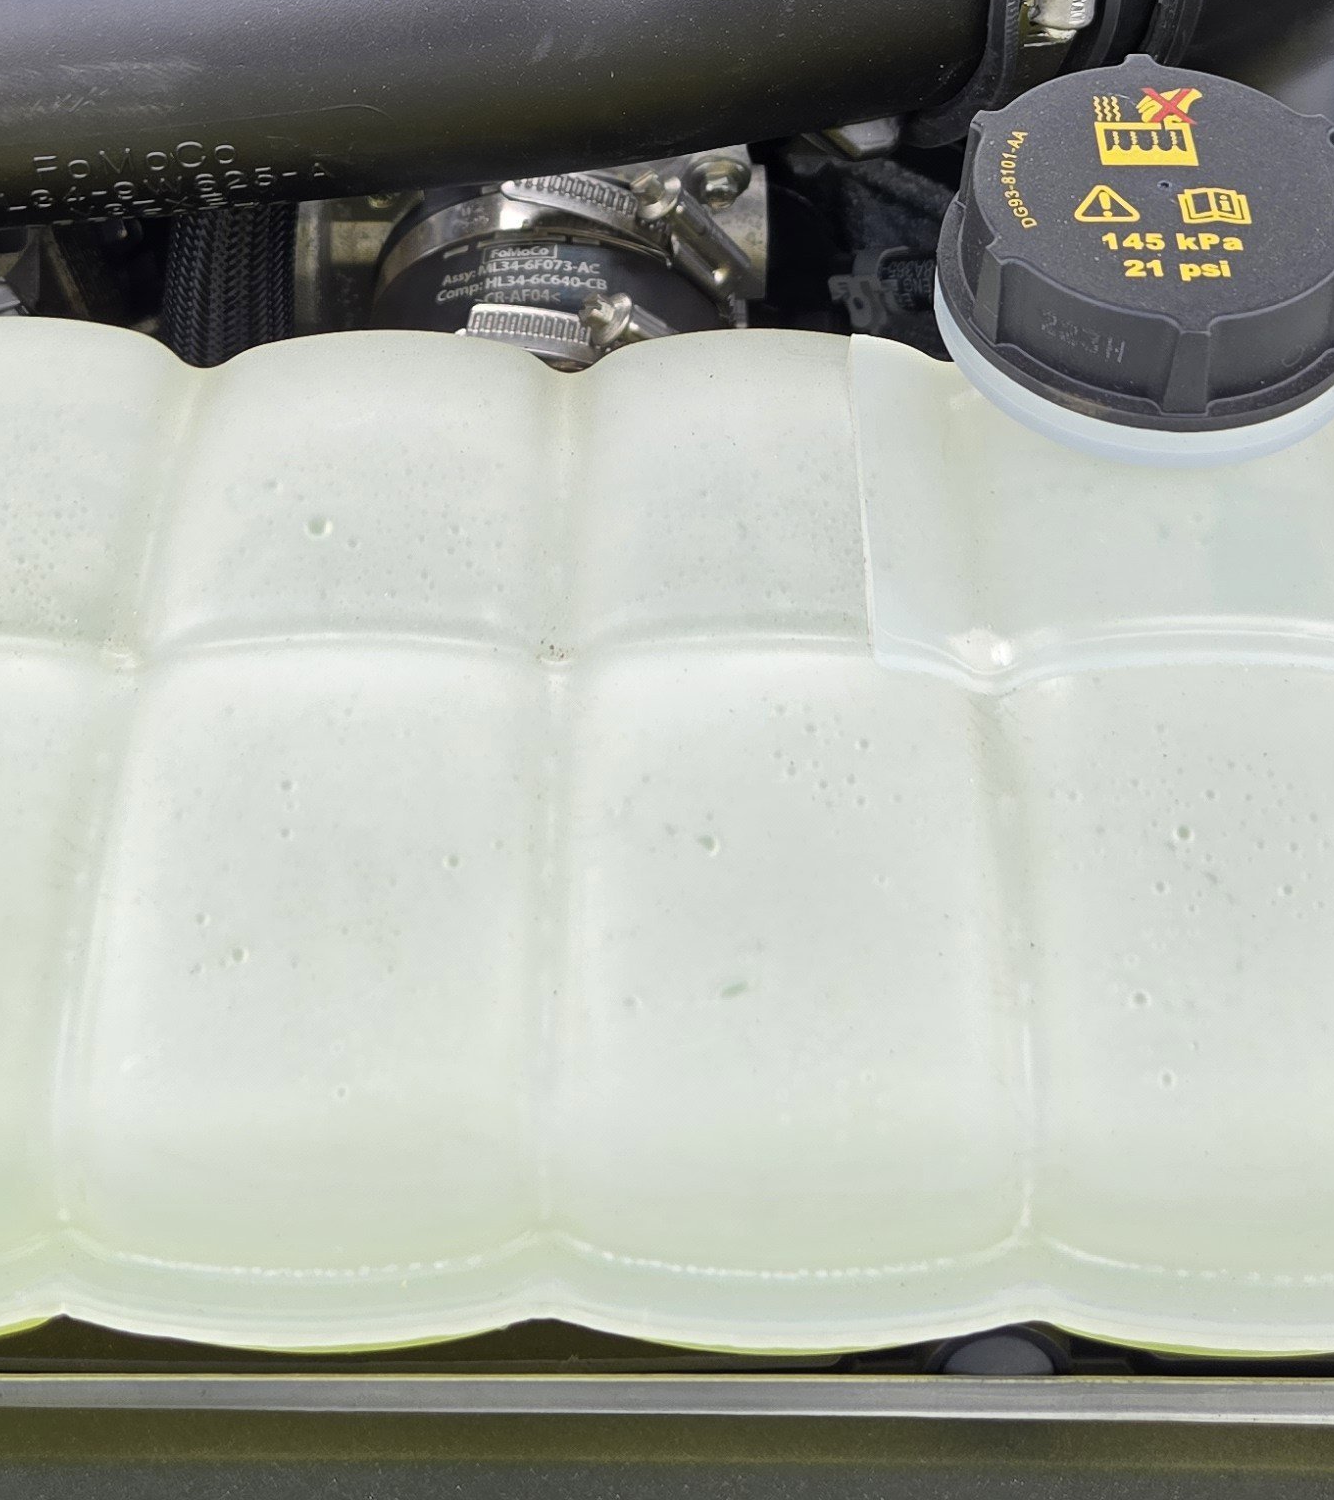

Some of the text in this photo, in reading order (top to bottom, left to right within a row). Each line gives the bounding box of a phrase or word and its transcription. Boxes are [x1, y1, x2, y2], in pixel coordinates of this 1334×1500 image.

[33, 140, 235, 181] FoMoCo
[1000, 131, 1037, 229] DG93-8101-AA
[491, 246, 549, 259] FoMoCo
[1102, 232, 1243, 250] 145 kPa
[442, 258, 600, 287] Assy: ML34-6F073-AC
[1123, 259, 1231, 281] 21 psi
[436, 273, 607, 302] Comp: HL34-6C640-CB
